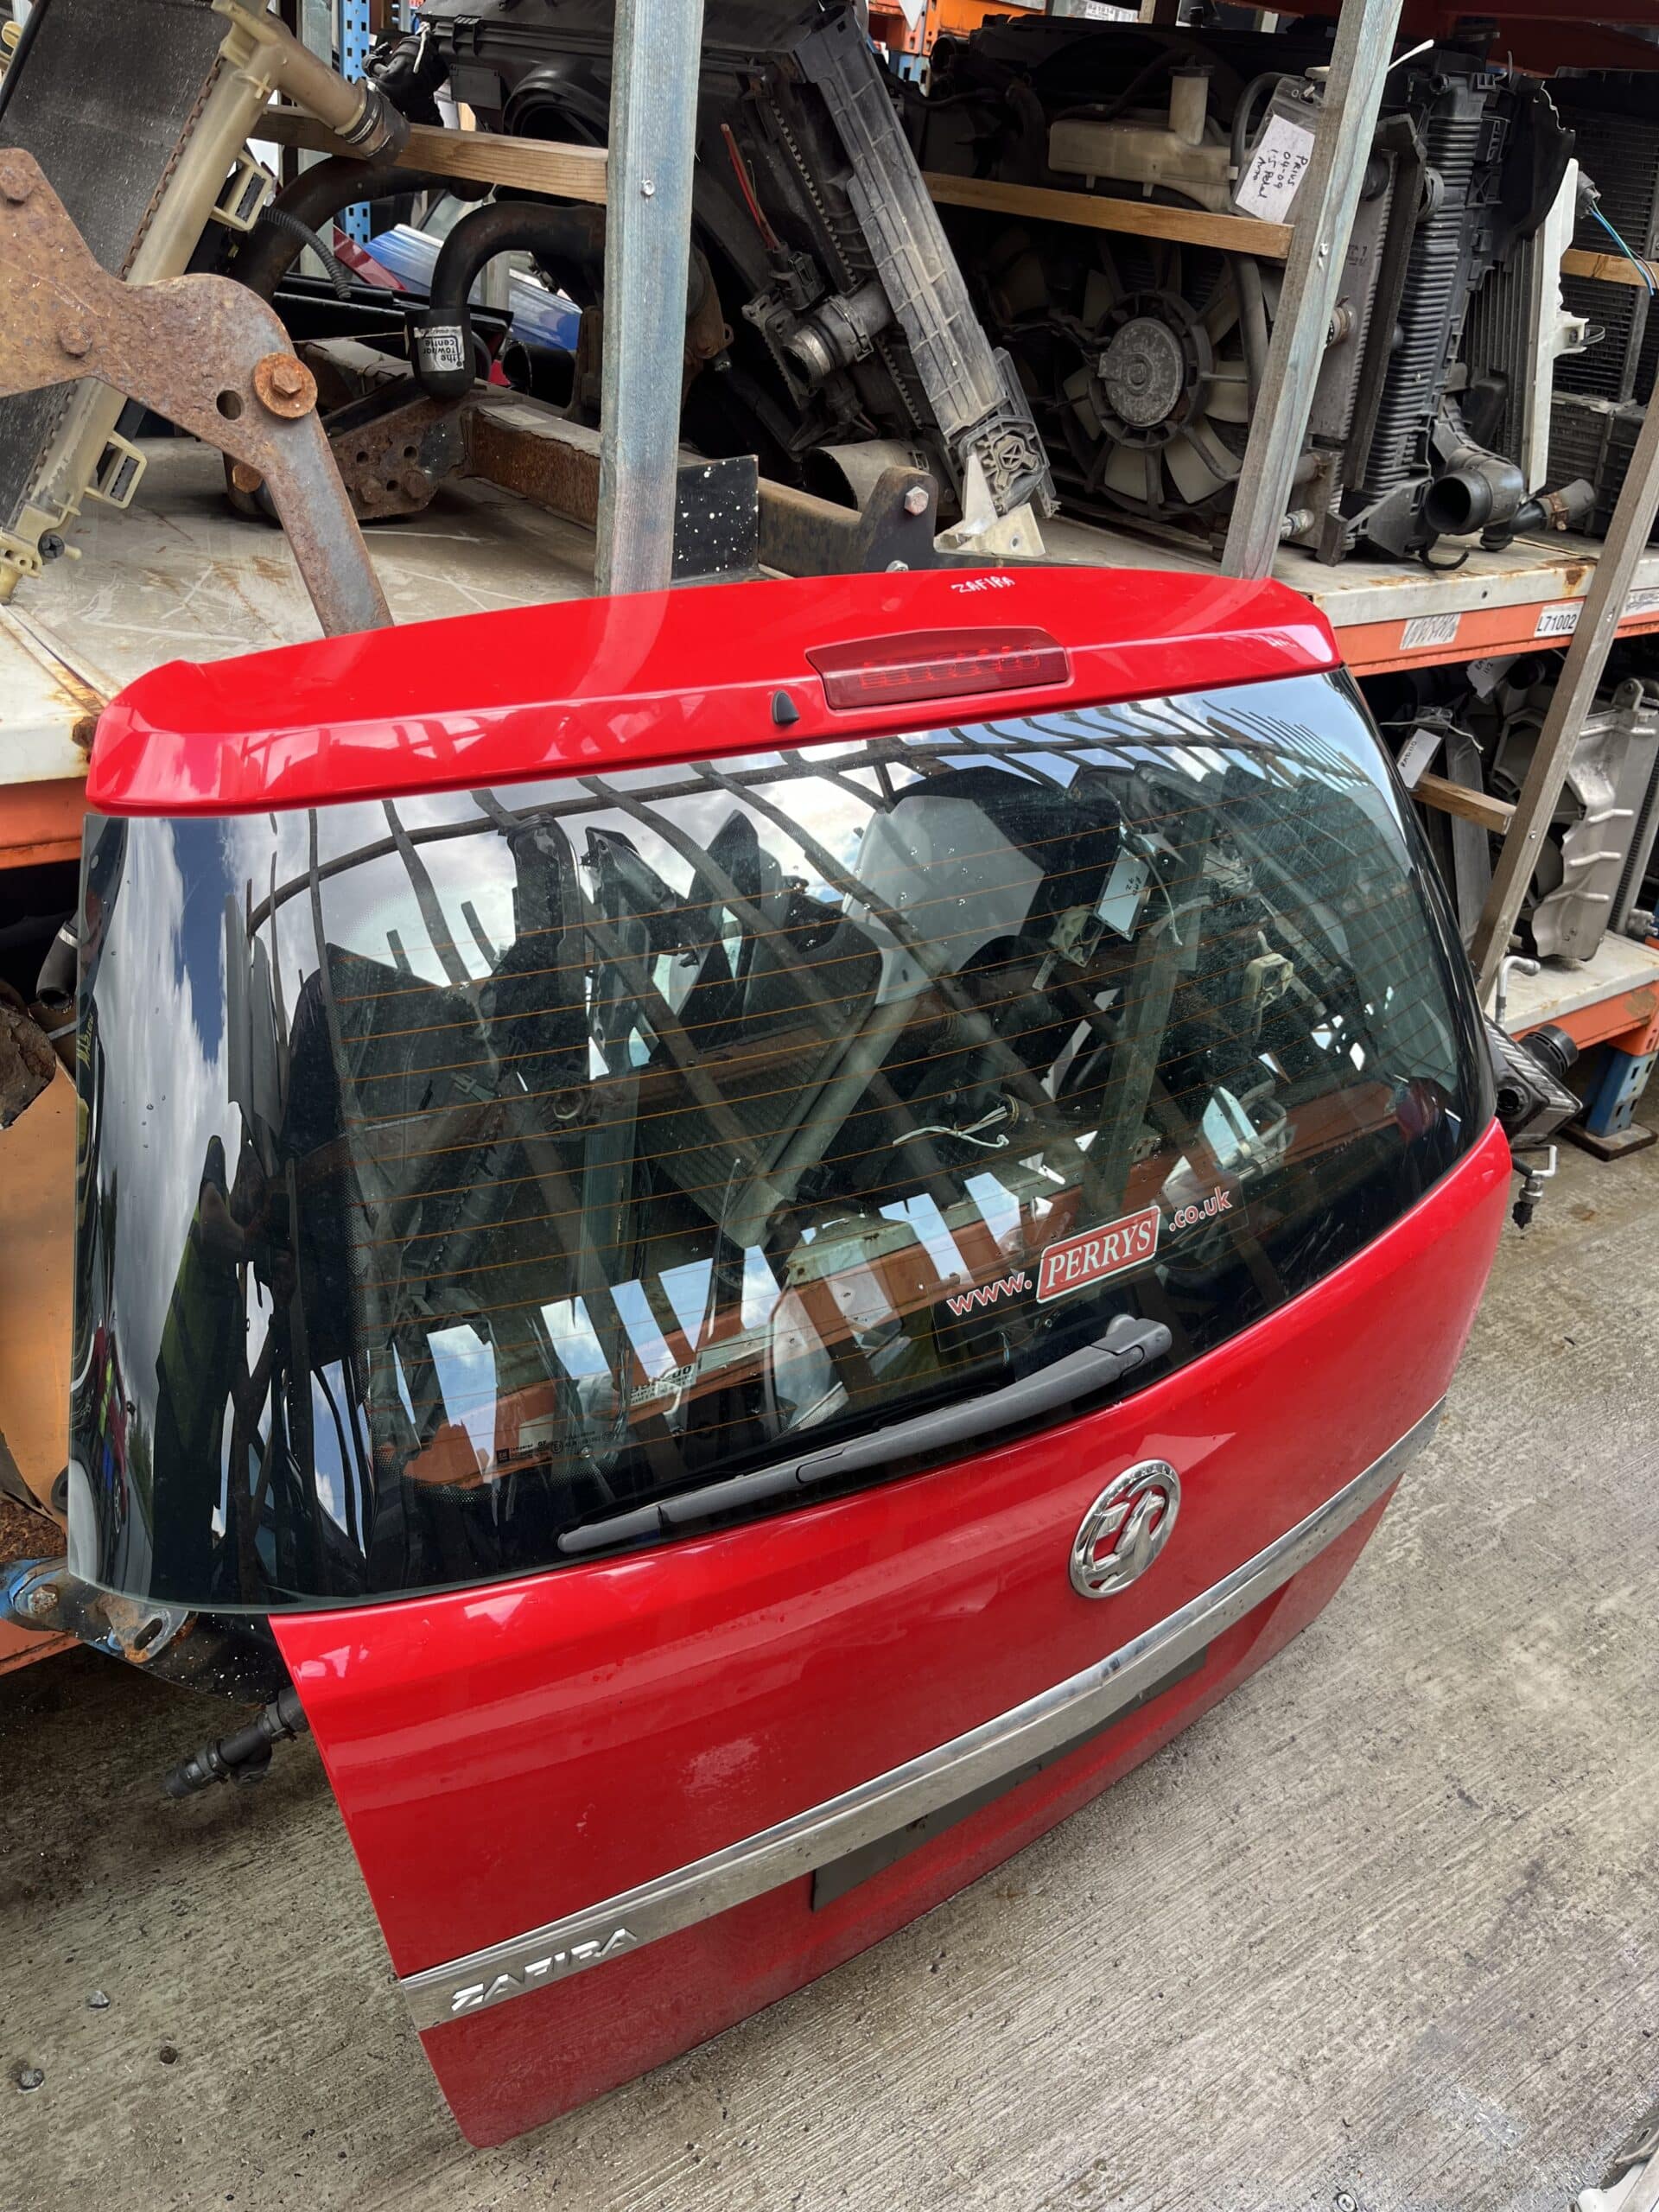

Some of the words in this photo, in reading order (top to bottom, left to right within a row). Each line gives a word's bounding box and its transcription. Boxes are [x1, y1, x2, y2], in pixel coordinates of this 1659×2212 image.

[950, 576, 1016, 594] ZAFIRA
[1536, 613, 1578, 632] L71002
[946, 1271, 1033, 1317] www.
[1046, 1219, 1153, 1289] PERRYS
[1168, 1186, 1233, 1232] .co.uk
[450, 1928, 638, 2013] ZAFIRA
